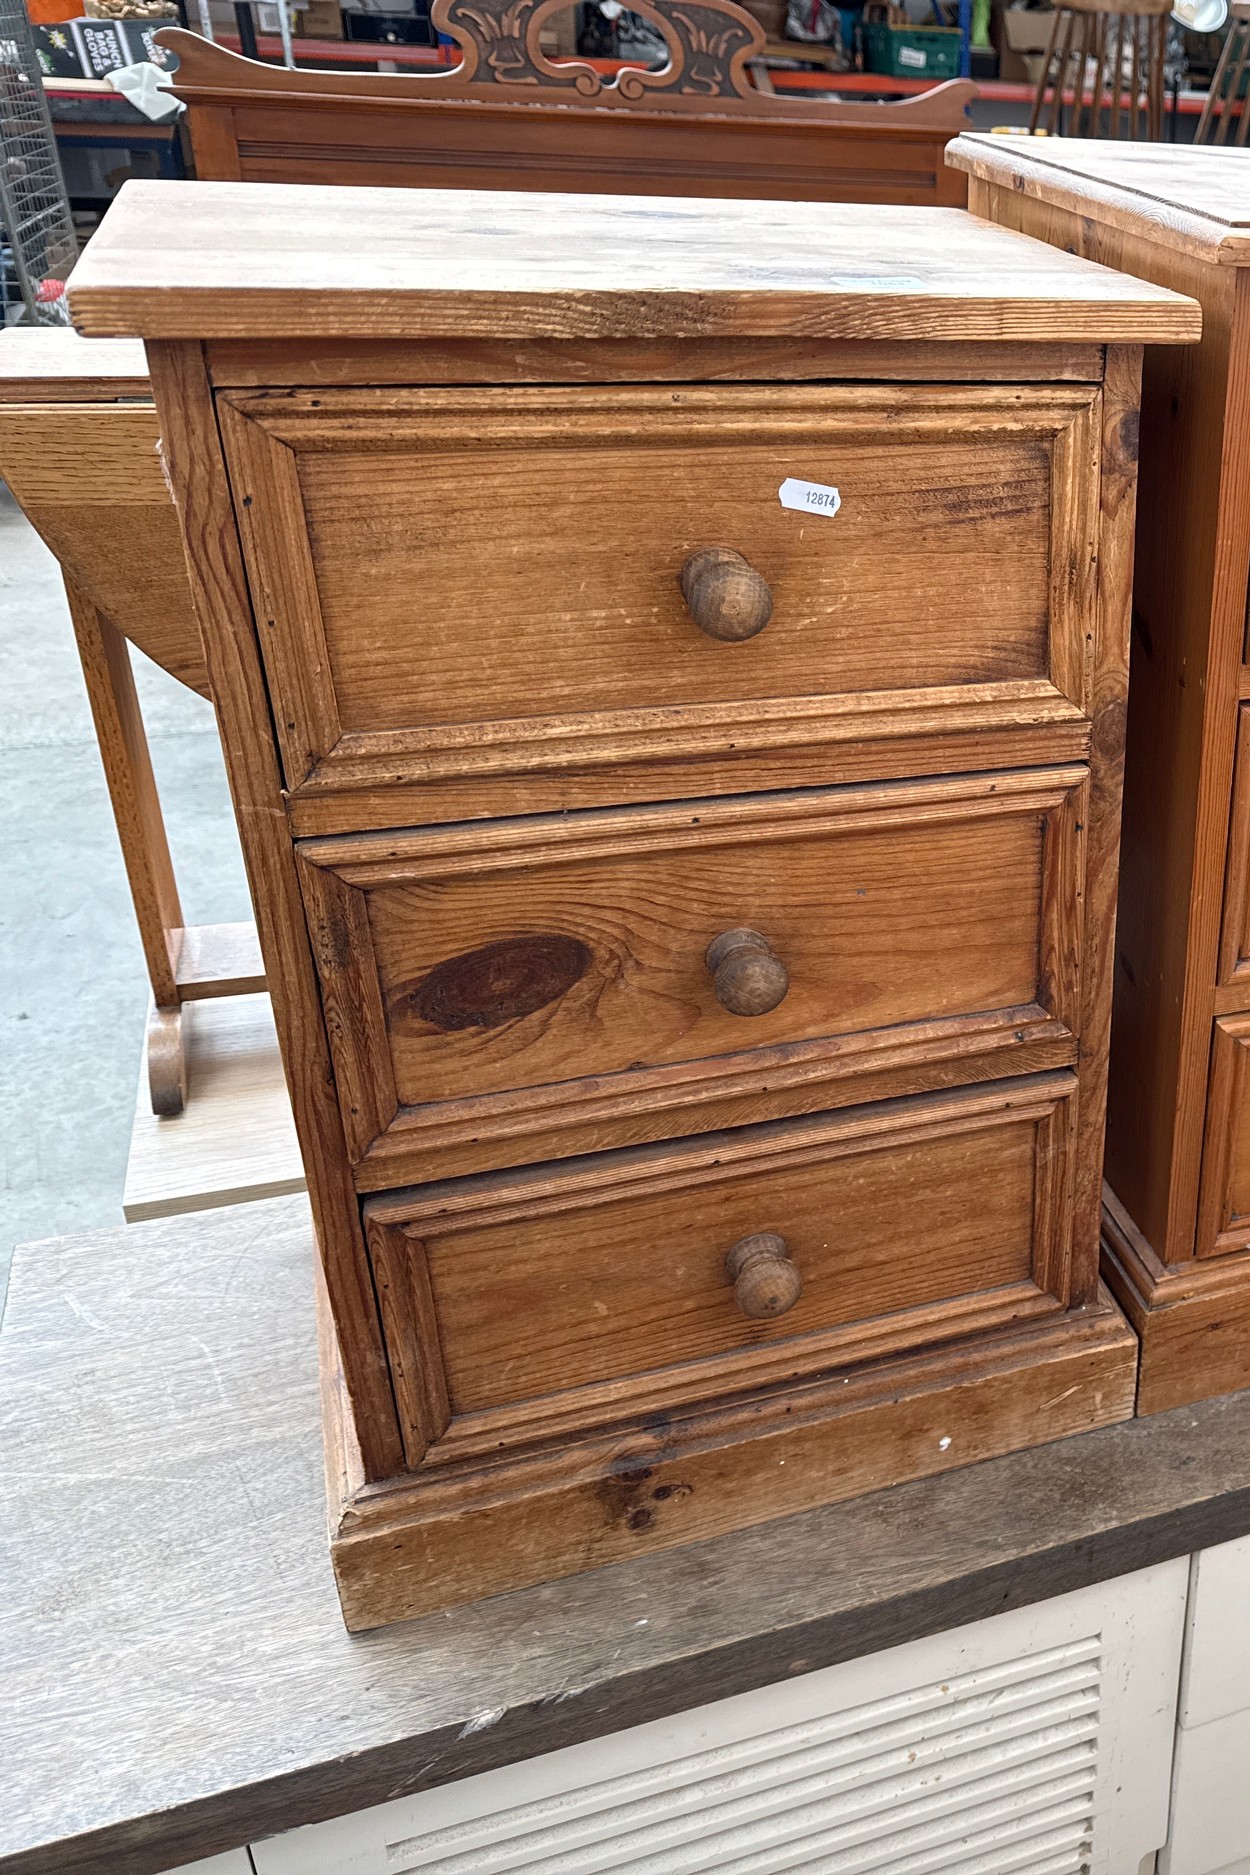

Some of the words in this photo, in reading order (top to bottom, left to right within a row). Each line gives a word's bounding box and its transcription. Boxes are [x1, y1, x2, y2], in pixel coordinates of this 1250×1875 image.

[83, 28, 104, 72] GLOVES
[94, 32, 109, 56] BAG
[102, 57, 112, 66] &
[103, 29, 123, 68] PUNCH
[806, 491, 835, 508] 12874
